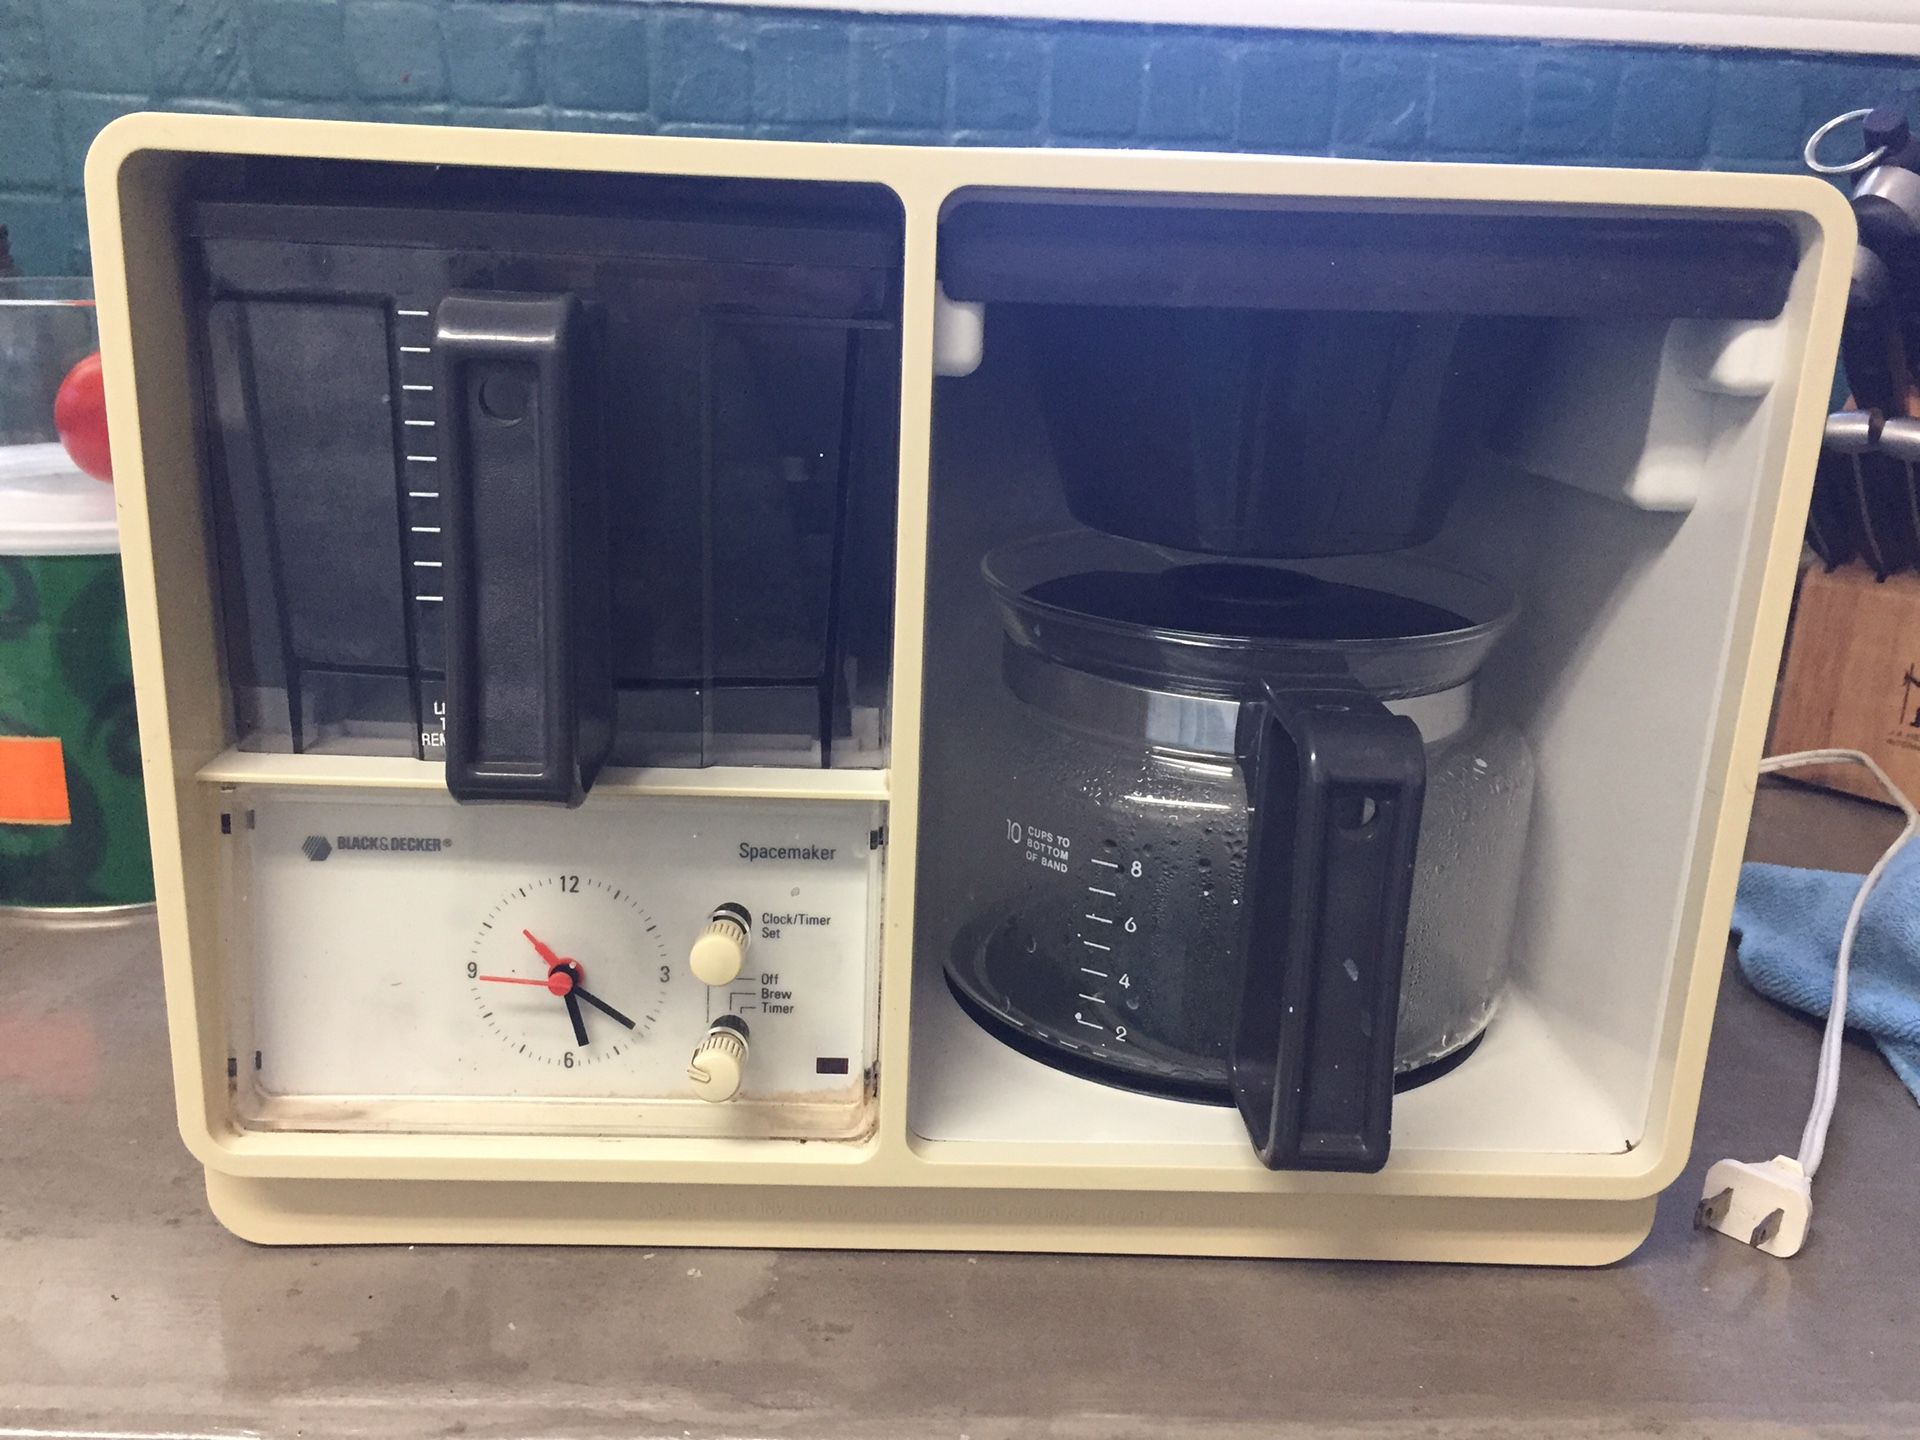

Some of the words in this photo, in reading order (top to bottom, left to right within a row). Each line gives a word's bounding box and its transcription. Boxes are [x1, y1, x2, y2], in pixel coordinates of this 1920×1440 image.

[1006, 818, 1022, 844] 10
[1028, 825, 1053, 843] CUPS
[1056, 835, 1070, 848] TO
[739, 842, 837, 862] Spacemaker
[1026, 838, 1069, 861] BOTTOM
[1025, 850, 1038, 863] OF
[1041, 857, 1068, 873] BAND
[1130, 860, 1143, 878] 8
[560, 875, 580, 893] 12
[761, 912, 832, 926] Clock/Timer
[1124, 916, 1137, 933] 6
[761, 926, 781, 939] Set
[467, 961, 478, 979] 9
[659, 965, 670, 983] 3
[761, 973, 779, 985] Off
[1118, 973, 1131, 989] 4
[761, 987, 792, 1000] Brew
[761, 1001, 795, 1014] Timer
[1115, 1025, 1127, 1042] 2
[563, 1051, 574, 1069] 6
